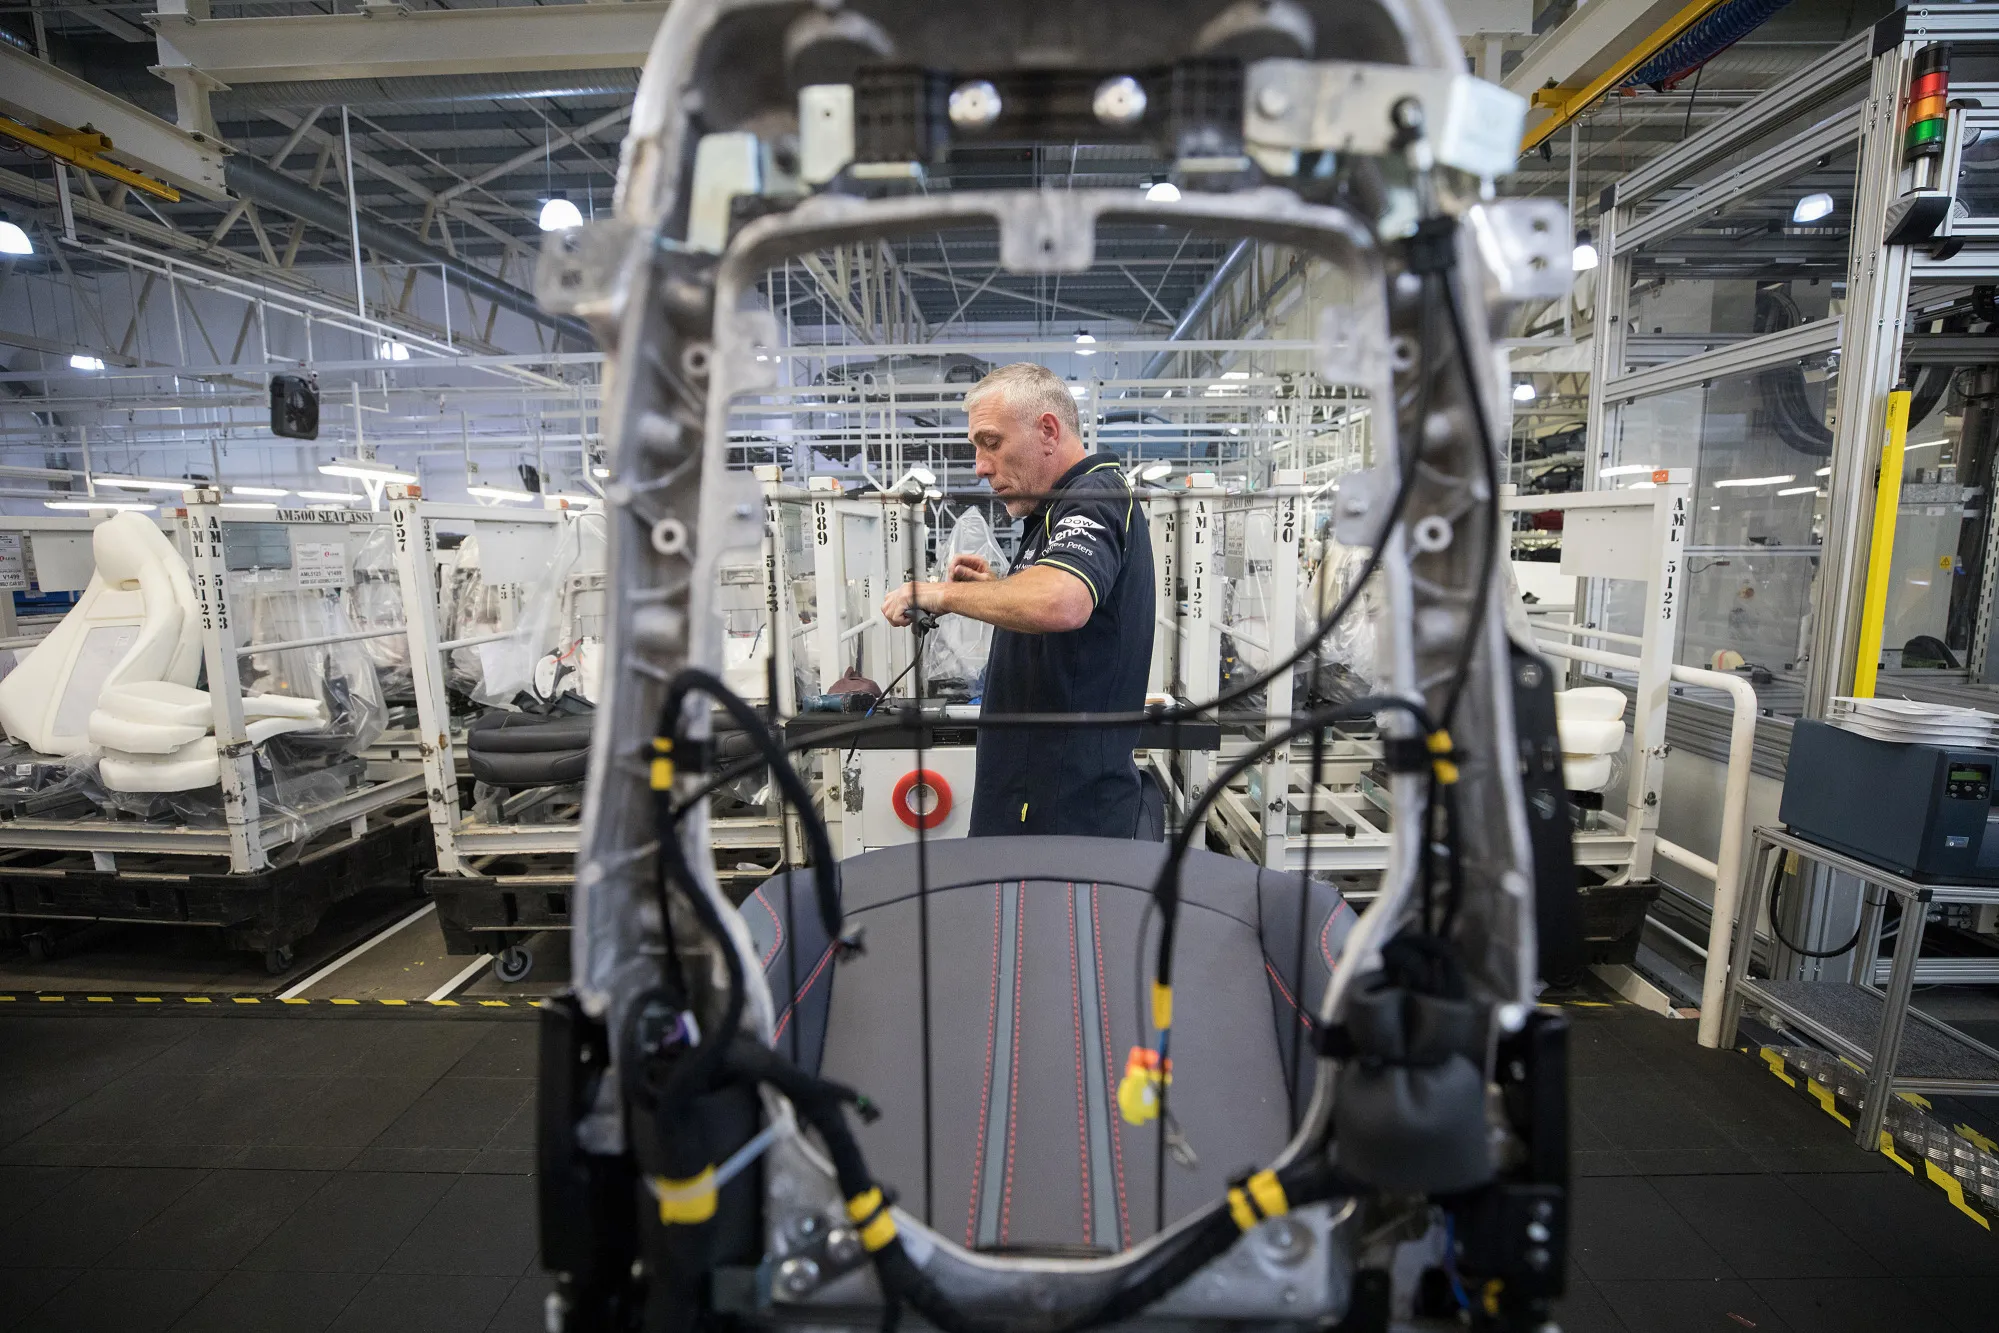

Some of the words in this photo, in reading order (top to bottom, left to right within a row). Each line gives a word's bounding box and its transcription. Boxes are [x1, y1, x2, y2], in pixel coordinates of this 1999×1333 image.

[208, 516, 222, 558] AML
[276, 509, 316, 522] AM500
[318, 510, 347, 523] SEAT
[394, 509, 407, 552] 057
[815, 501, 828, 546] 689
[889, 510, 899, 543] 239
[1048, 527, 1097, 546] Lenovo
[1164, 513, 1176, 543] AML
[1195, 500, 1208, 545] AML
[1282, 496, 1295, 544] 420
[1671, 497, 1687, 542] AML
[1066, 541, 1094, 557] Peters
[191, 516, 204, 558] AML
[198, 574, 212, 630] 5123
[1164, 555, 1172, 598] 5123
[1193, 561, 1203, 619] 5123
[1662, 560, 1676, 620] 5123
[214, 574, 228, 630] 5123
